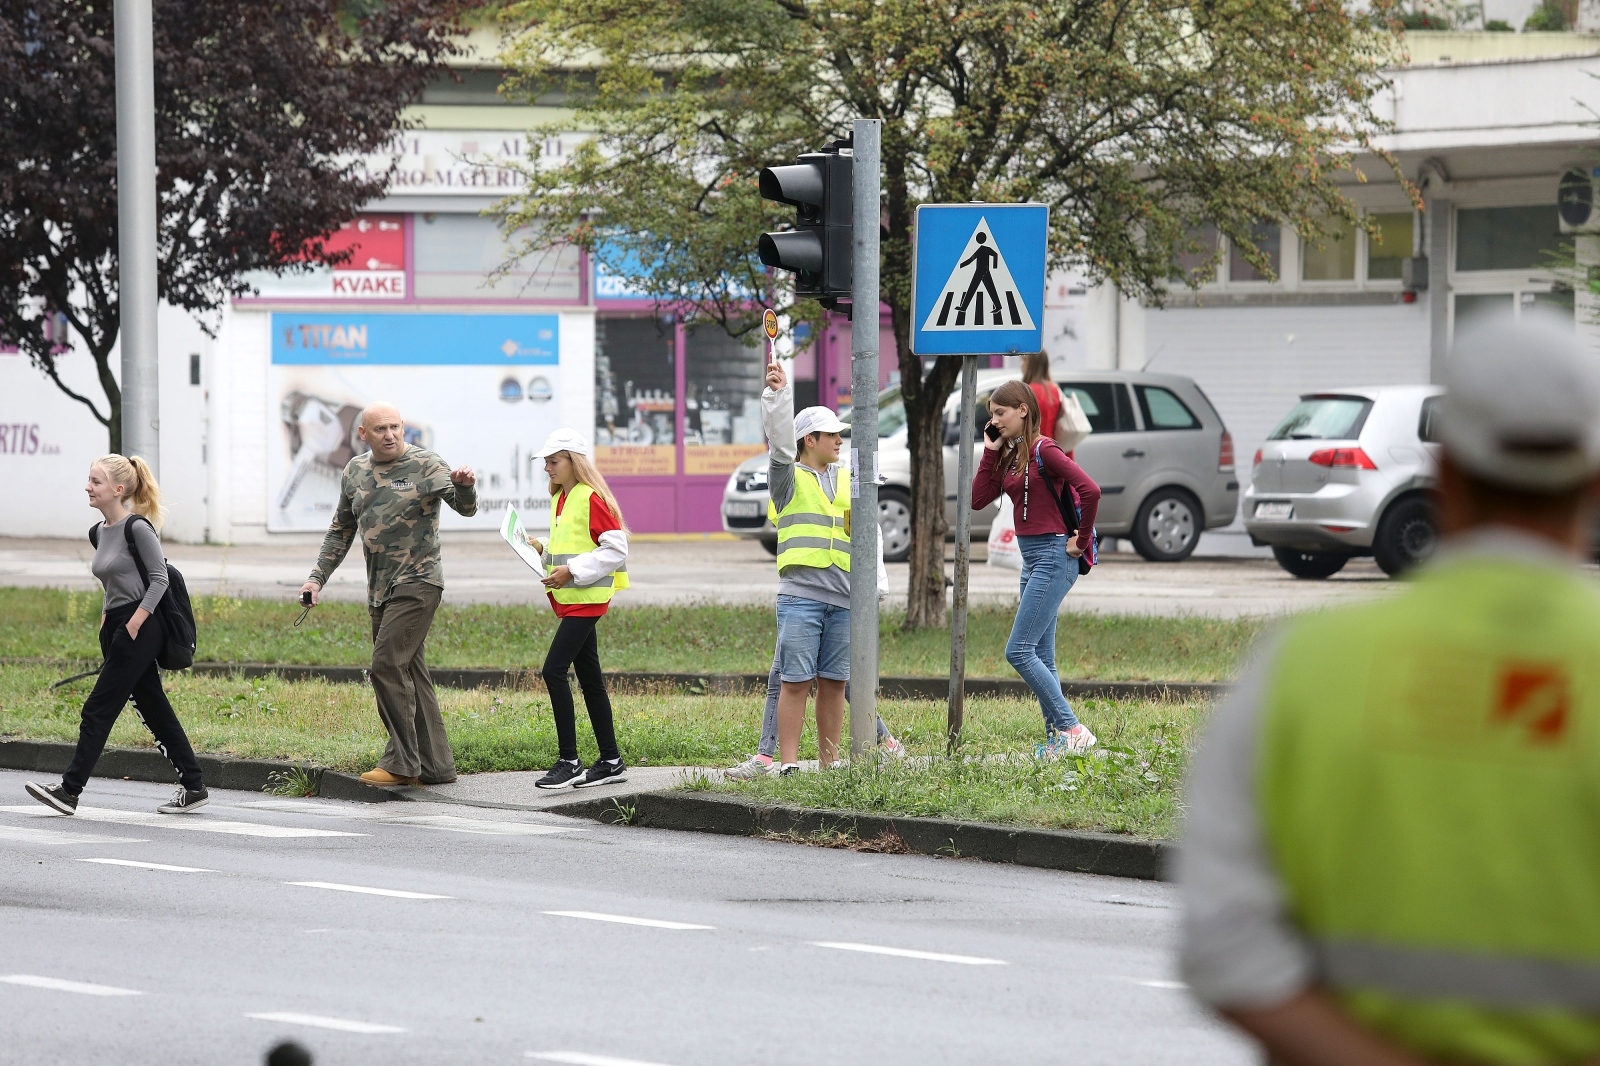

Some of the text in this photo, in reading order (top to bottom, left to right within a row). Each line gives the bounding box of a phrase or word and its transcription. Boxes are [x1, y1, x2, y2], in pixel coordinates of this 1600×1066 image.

[498, 138, 563, 156] ALTI
[333, 276, 402, 293] KVAKE
[298, 323, 367, 349] TITAN
